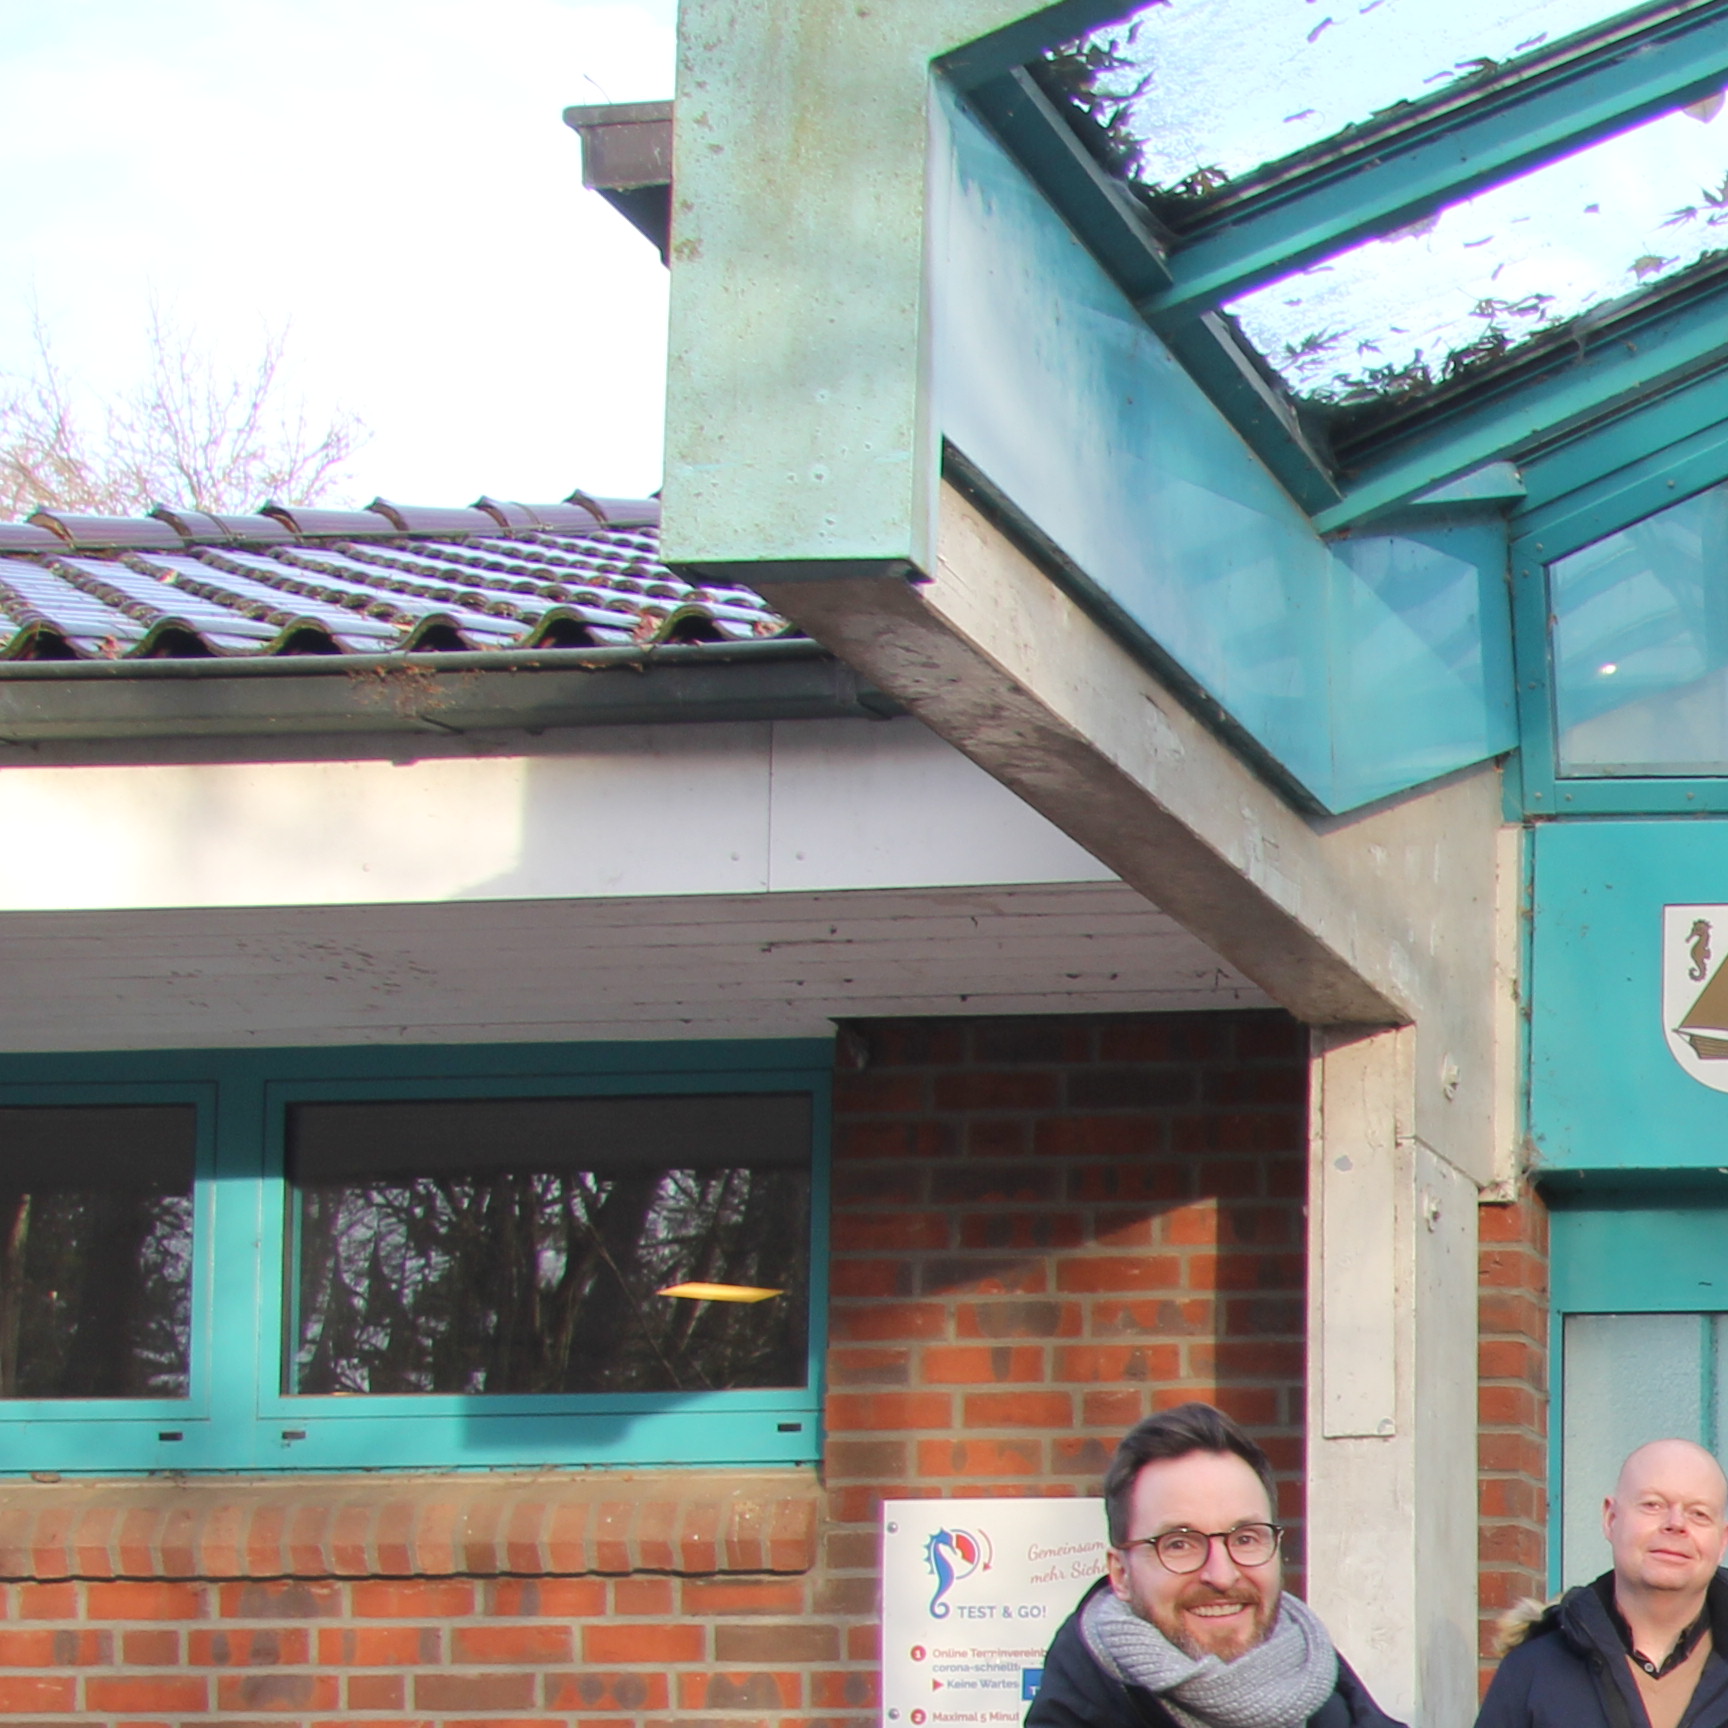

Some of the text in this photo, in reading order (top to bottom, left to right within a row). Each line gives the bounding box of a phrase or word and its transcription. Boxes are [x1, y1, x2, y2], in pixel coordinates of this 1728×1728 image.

[1028, 1541, 1106, 1561] Gemeinsam
[1030, 1566, 1066, 1584] mehr
[957, 1605, 1047, 1619] TEST & GO!
[932, 1649, 968, 1658] Online
[970, 1648, 1047, 1659] Terminvereinb
[932, 1662, 1019, 1673] corona-schnellt
[947, 1679, 1019, 1689] Keine Wartes
[932, 1712, 978, 1722] Maximal
[981, 1713, 987, 1723] 5
[989, 1711, 1019, 1721] Minut
